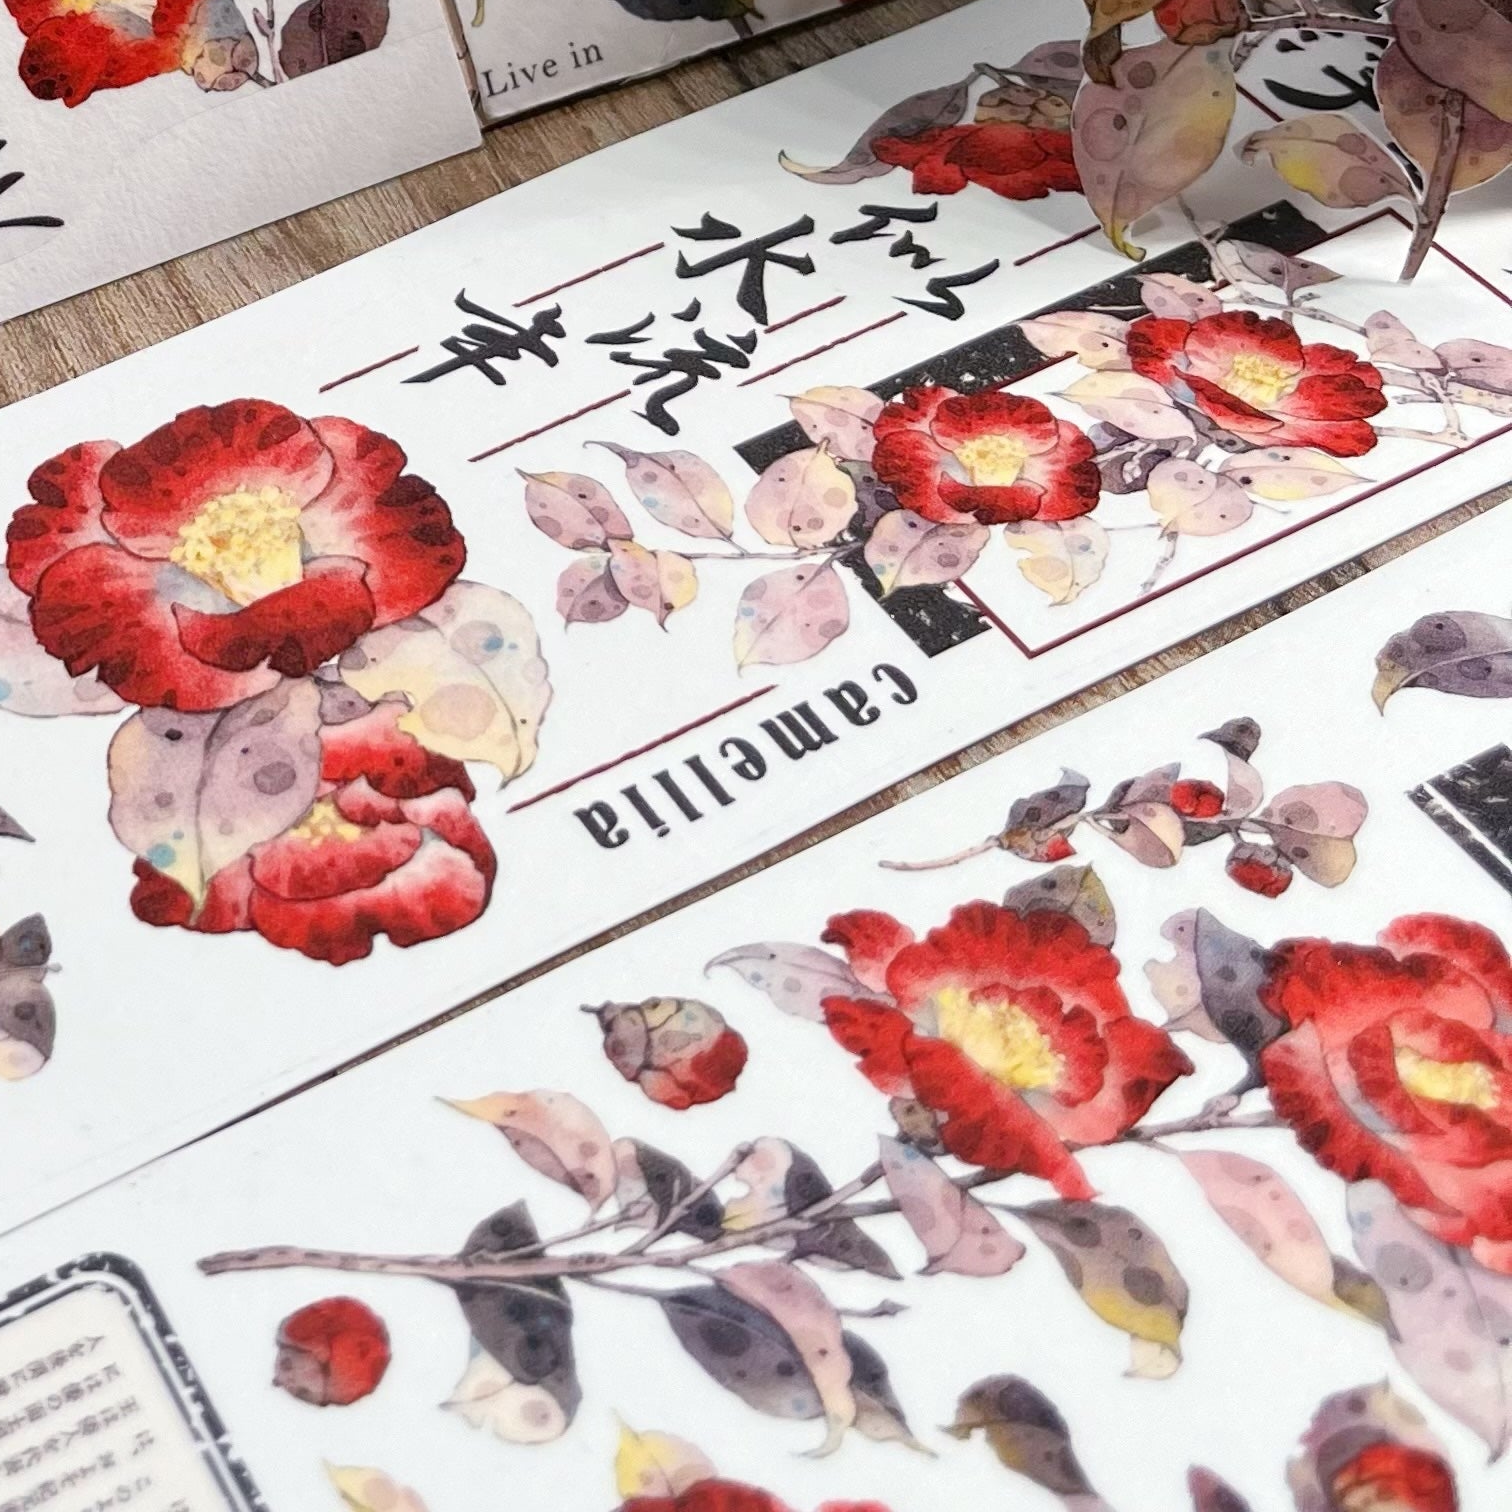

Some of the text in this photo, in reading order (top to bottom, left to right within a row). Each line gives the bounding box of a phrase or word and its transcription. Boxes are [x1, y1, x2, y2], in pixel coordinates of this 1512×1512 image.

[480, 41, 604, 98] Live in
[573, 662, 919, 849] camellia
